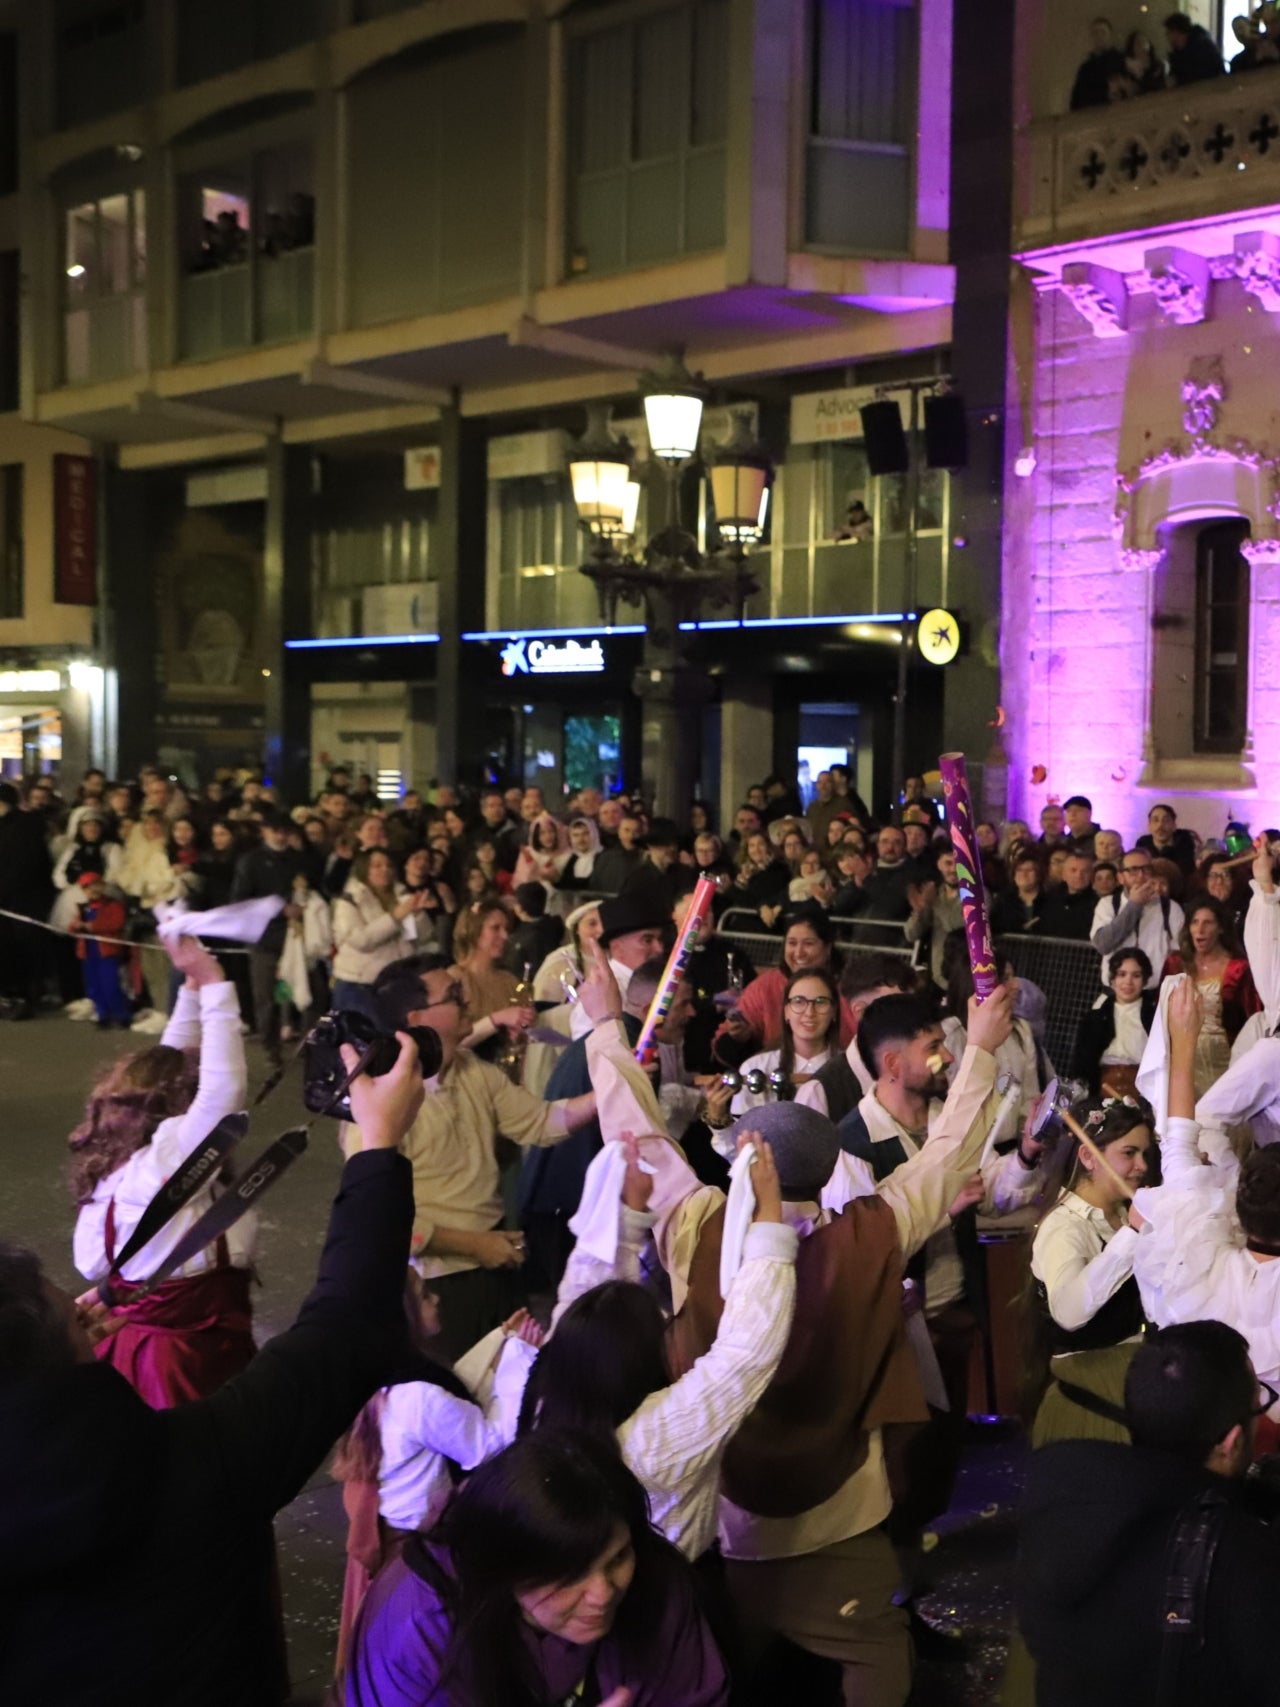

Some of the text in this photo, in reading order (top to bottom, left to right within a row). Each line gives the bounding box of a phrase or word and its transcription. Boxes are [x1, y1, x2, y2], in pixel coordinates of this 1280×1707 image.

[67, 462, 86, 576] MEDICAL
[168, 1147, 219, 1199] Canon
[238, 1162, 276, 1198] EOS
